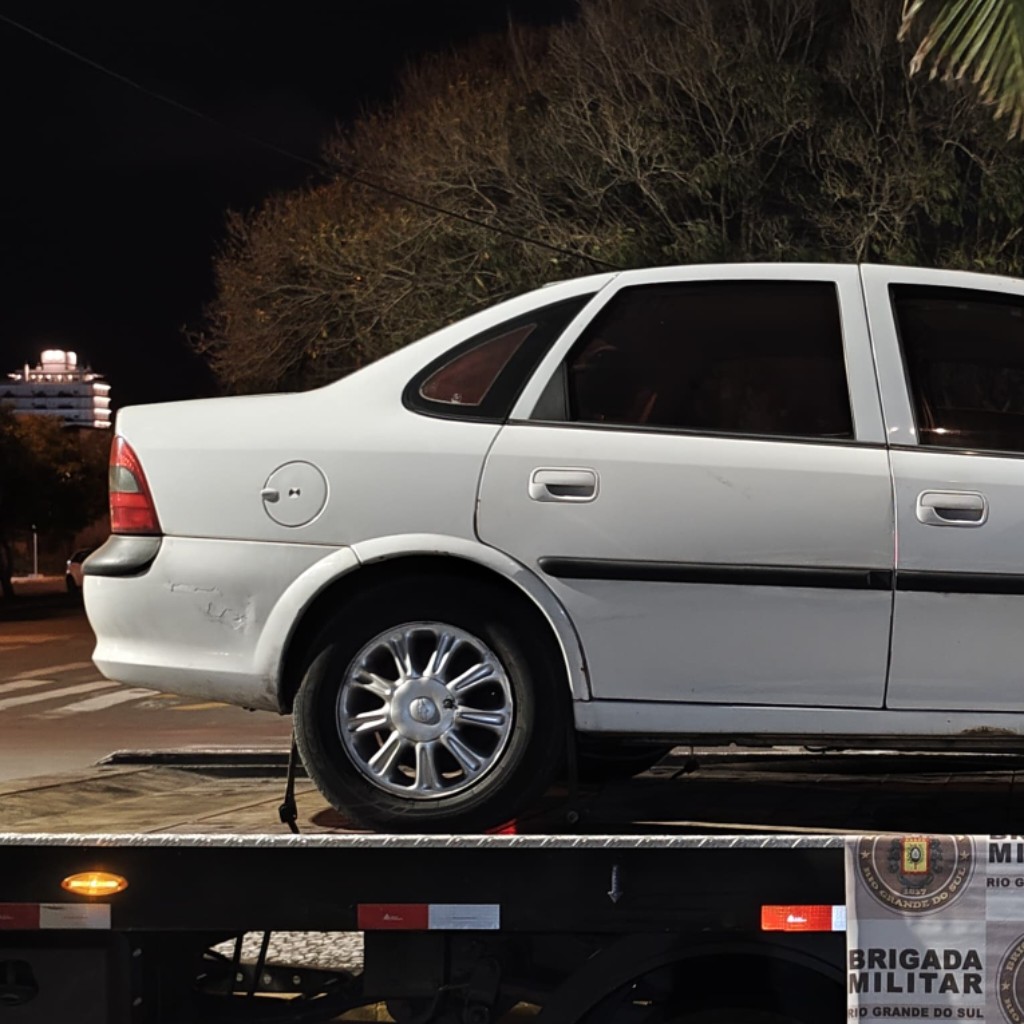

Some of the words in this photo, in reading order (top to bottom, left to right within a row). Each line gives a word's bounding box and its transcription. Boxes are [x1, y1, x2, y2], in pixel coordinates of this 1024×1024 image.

[863, 867, 878, 889] RIO
[880, 889, 929, 908] GRANDE
[933, 892, 948, 905] DO
[950, 867, 966, 893] SUL
[987, 878, 1010, 887] RIO
[849, 949, 982, 970] BRIGADA
[849, 972, 982, 994] MILITAR
[849, 1007, 867, 1017] RIO
[873, 1007, 928, 1017] GRANDE
[934, 1007, 952, 1017] DO
[958, 1008, 983, 1017] SUL
[1004, 999, 1019, 1022] RIO
